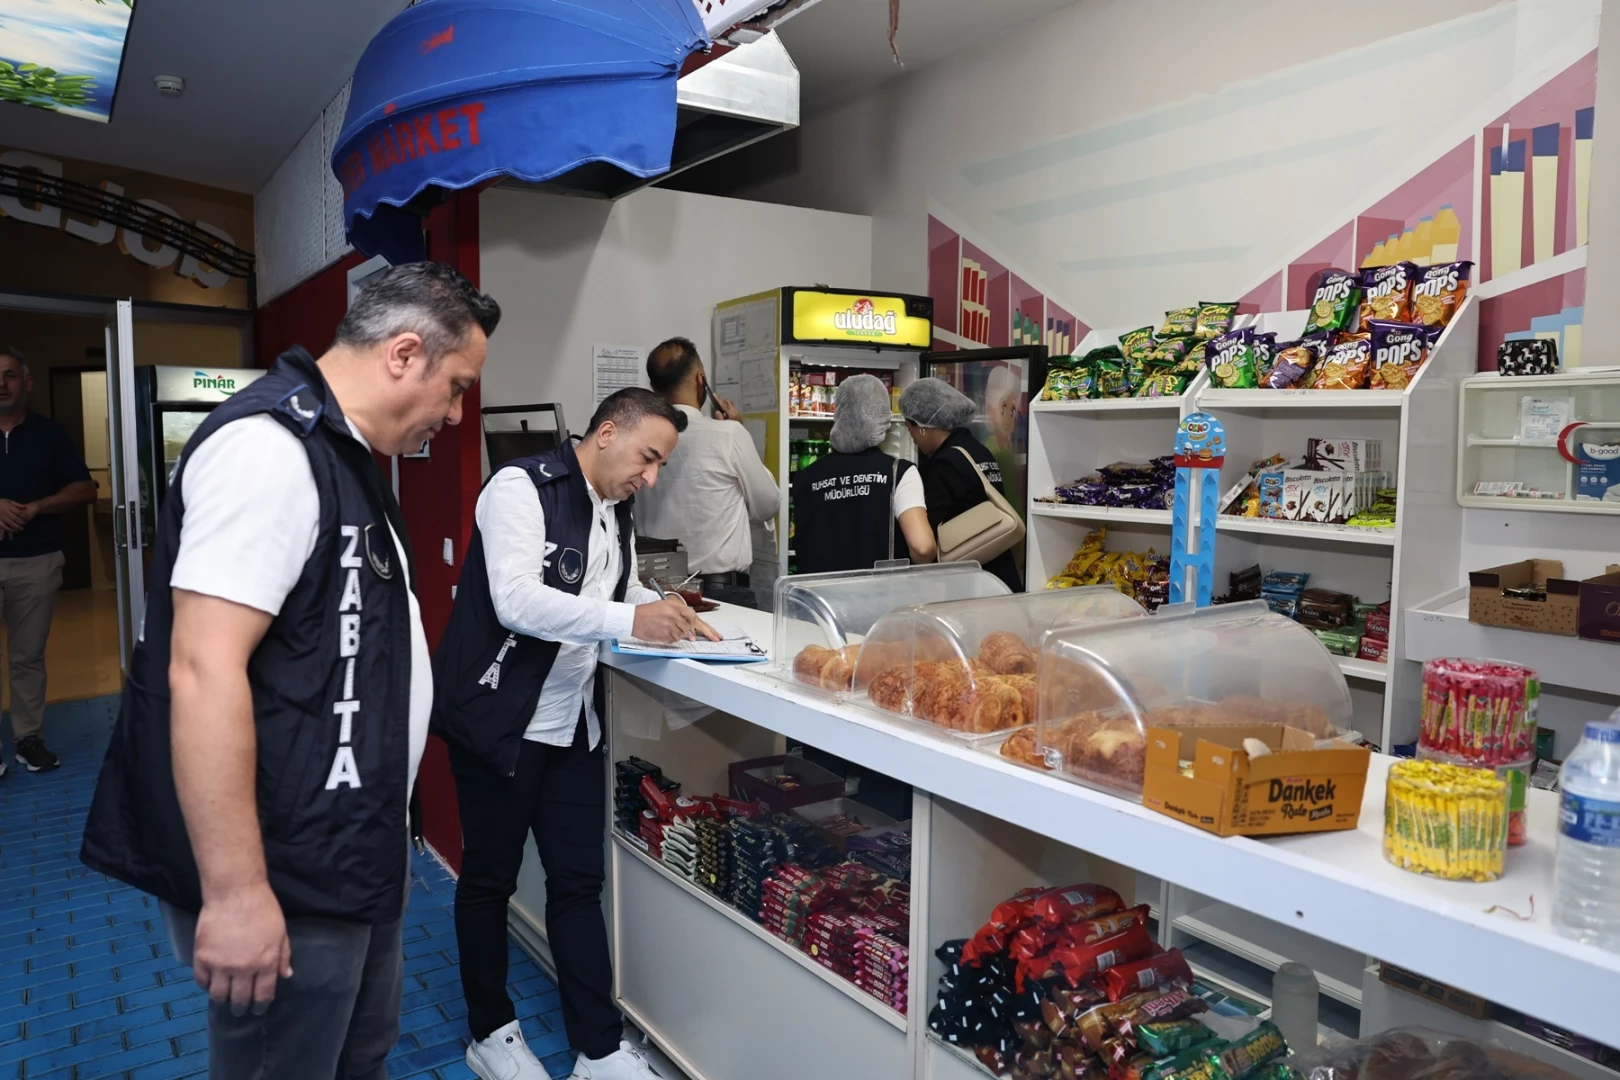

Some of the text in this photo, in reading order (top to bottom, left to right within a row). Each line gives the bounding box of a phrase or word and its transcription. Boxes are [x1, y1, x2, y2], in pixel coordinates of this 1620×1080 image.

[365, 101, 485, 176] MARKET
[1367, 271, 1408, 304] POPS
[1375, 267, 1398, 282] Gong
[1415, 271, 1459, 301] POPS
[1314, 279, 1352, 306] POPS
[834, 308, 897, 336] uludağ
[1387, 332, 1413, 344] Gong
[1211, 339, 1246, 372] POPS
[1376, 339, 1422, 371] POPS
[193, 377, 235, 392] PINAR
[1590, 447, 1619, 456] b-good
[812, 471, 888, 493] RUHSAT VE DENETİM
[824, 485, 871, 501] MÜDÜRLÜĞÜ
[1284, 474, 1312, 485] Biscolata
[1313, 476, 1342, 486] Biscolata
[325, 525, 363, 791] ZABITA
[1268, 778, 1337, 805] Dankek
[1281, 803, 1308, 821] Rulo
[1141, 989, 1188, 1018] Albeni
